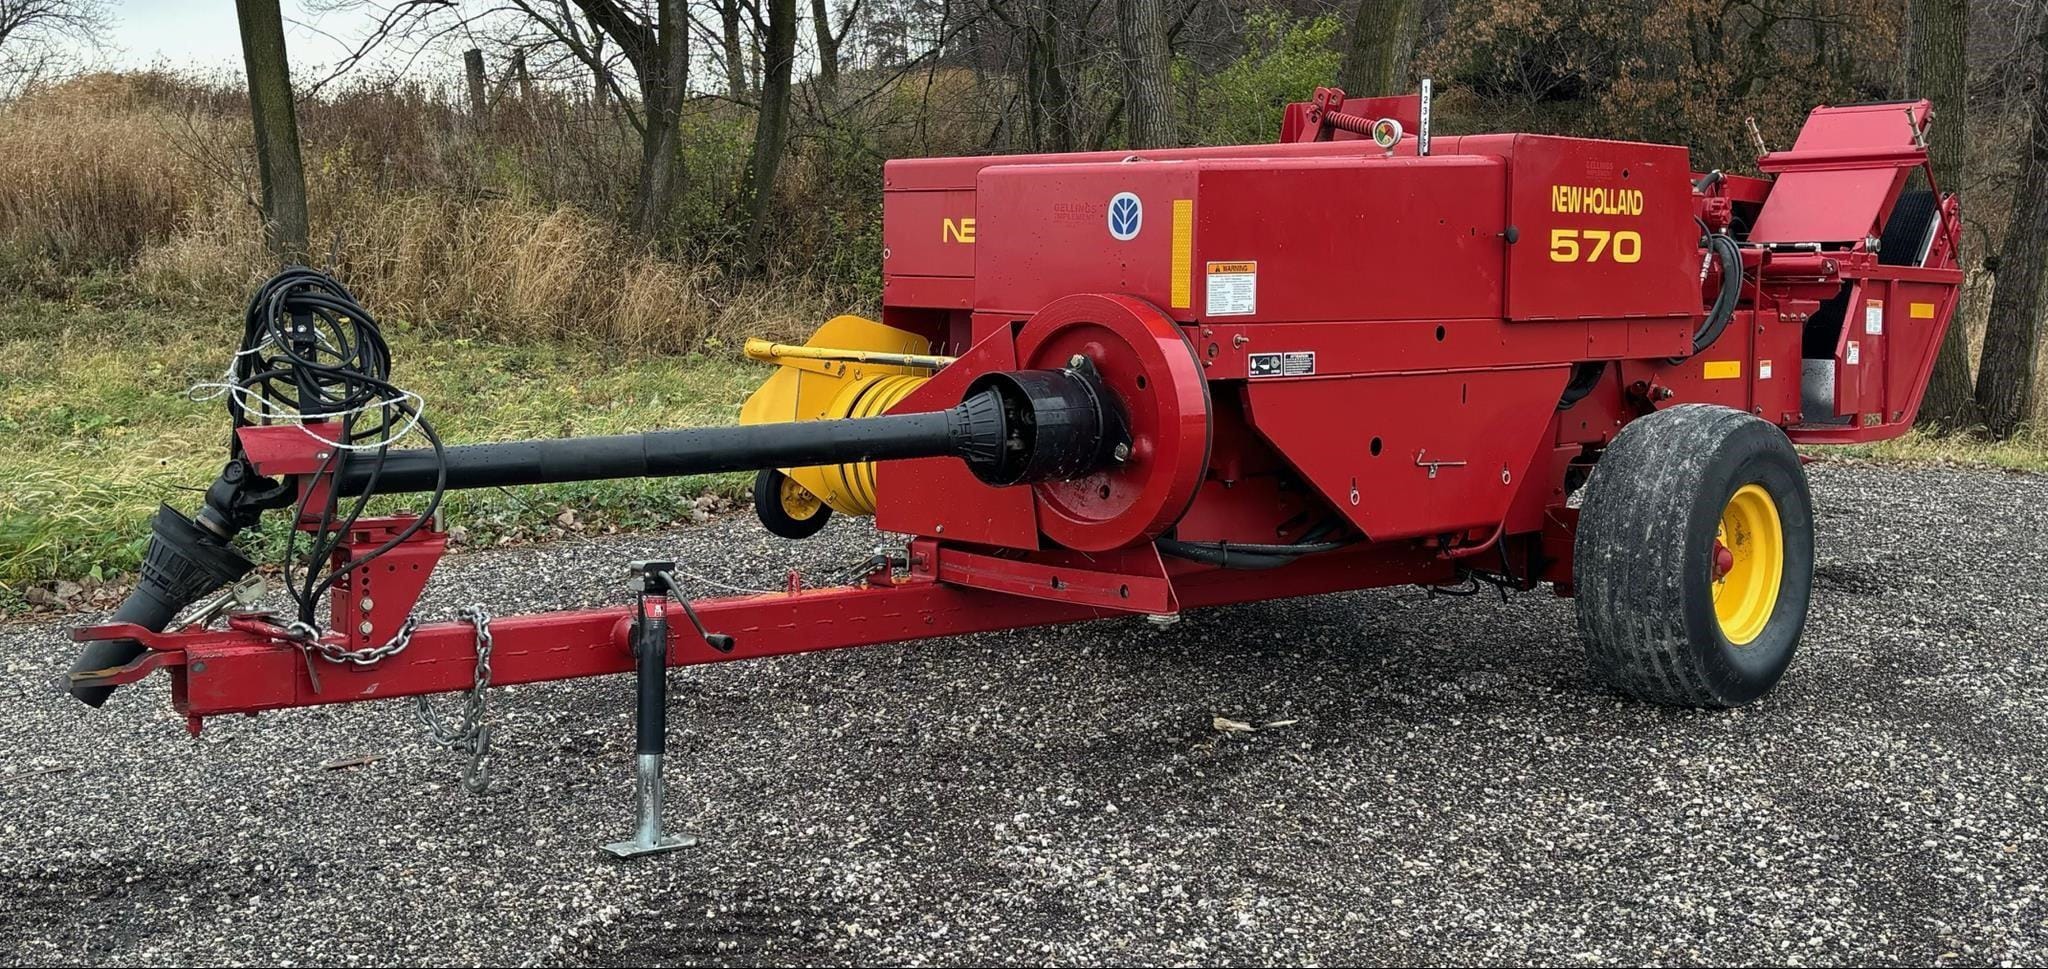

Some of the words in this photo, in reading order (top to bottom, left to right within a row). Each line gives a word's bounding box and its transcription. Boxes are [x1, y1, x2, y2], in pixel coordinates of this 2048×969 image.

[1423, 95, 1429, 104] 2
[1423, 106, 1428, 115] 3
[1552, 185, 1582, 213] NEW
[1583, 187, 1644, 216] HOLLAND
[943, 218, 976, 243] NE
[1550, 229, 1642, 263] 570
